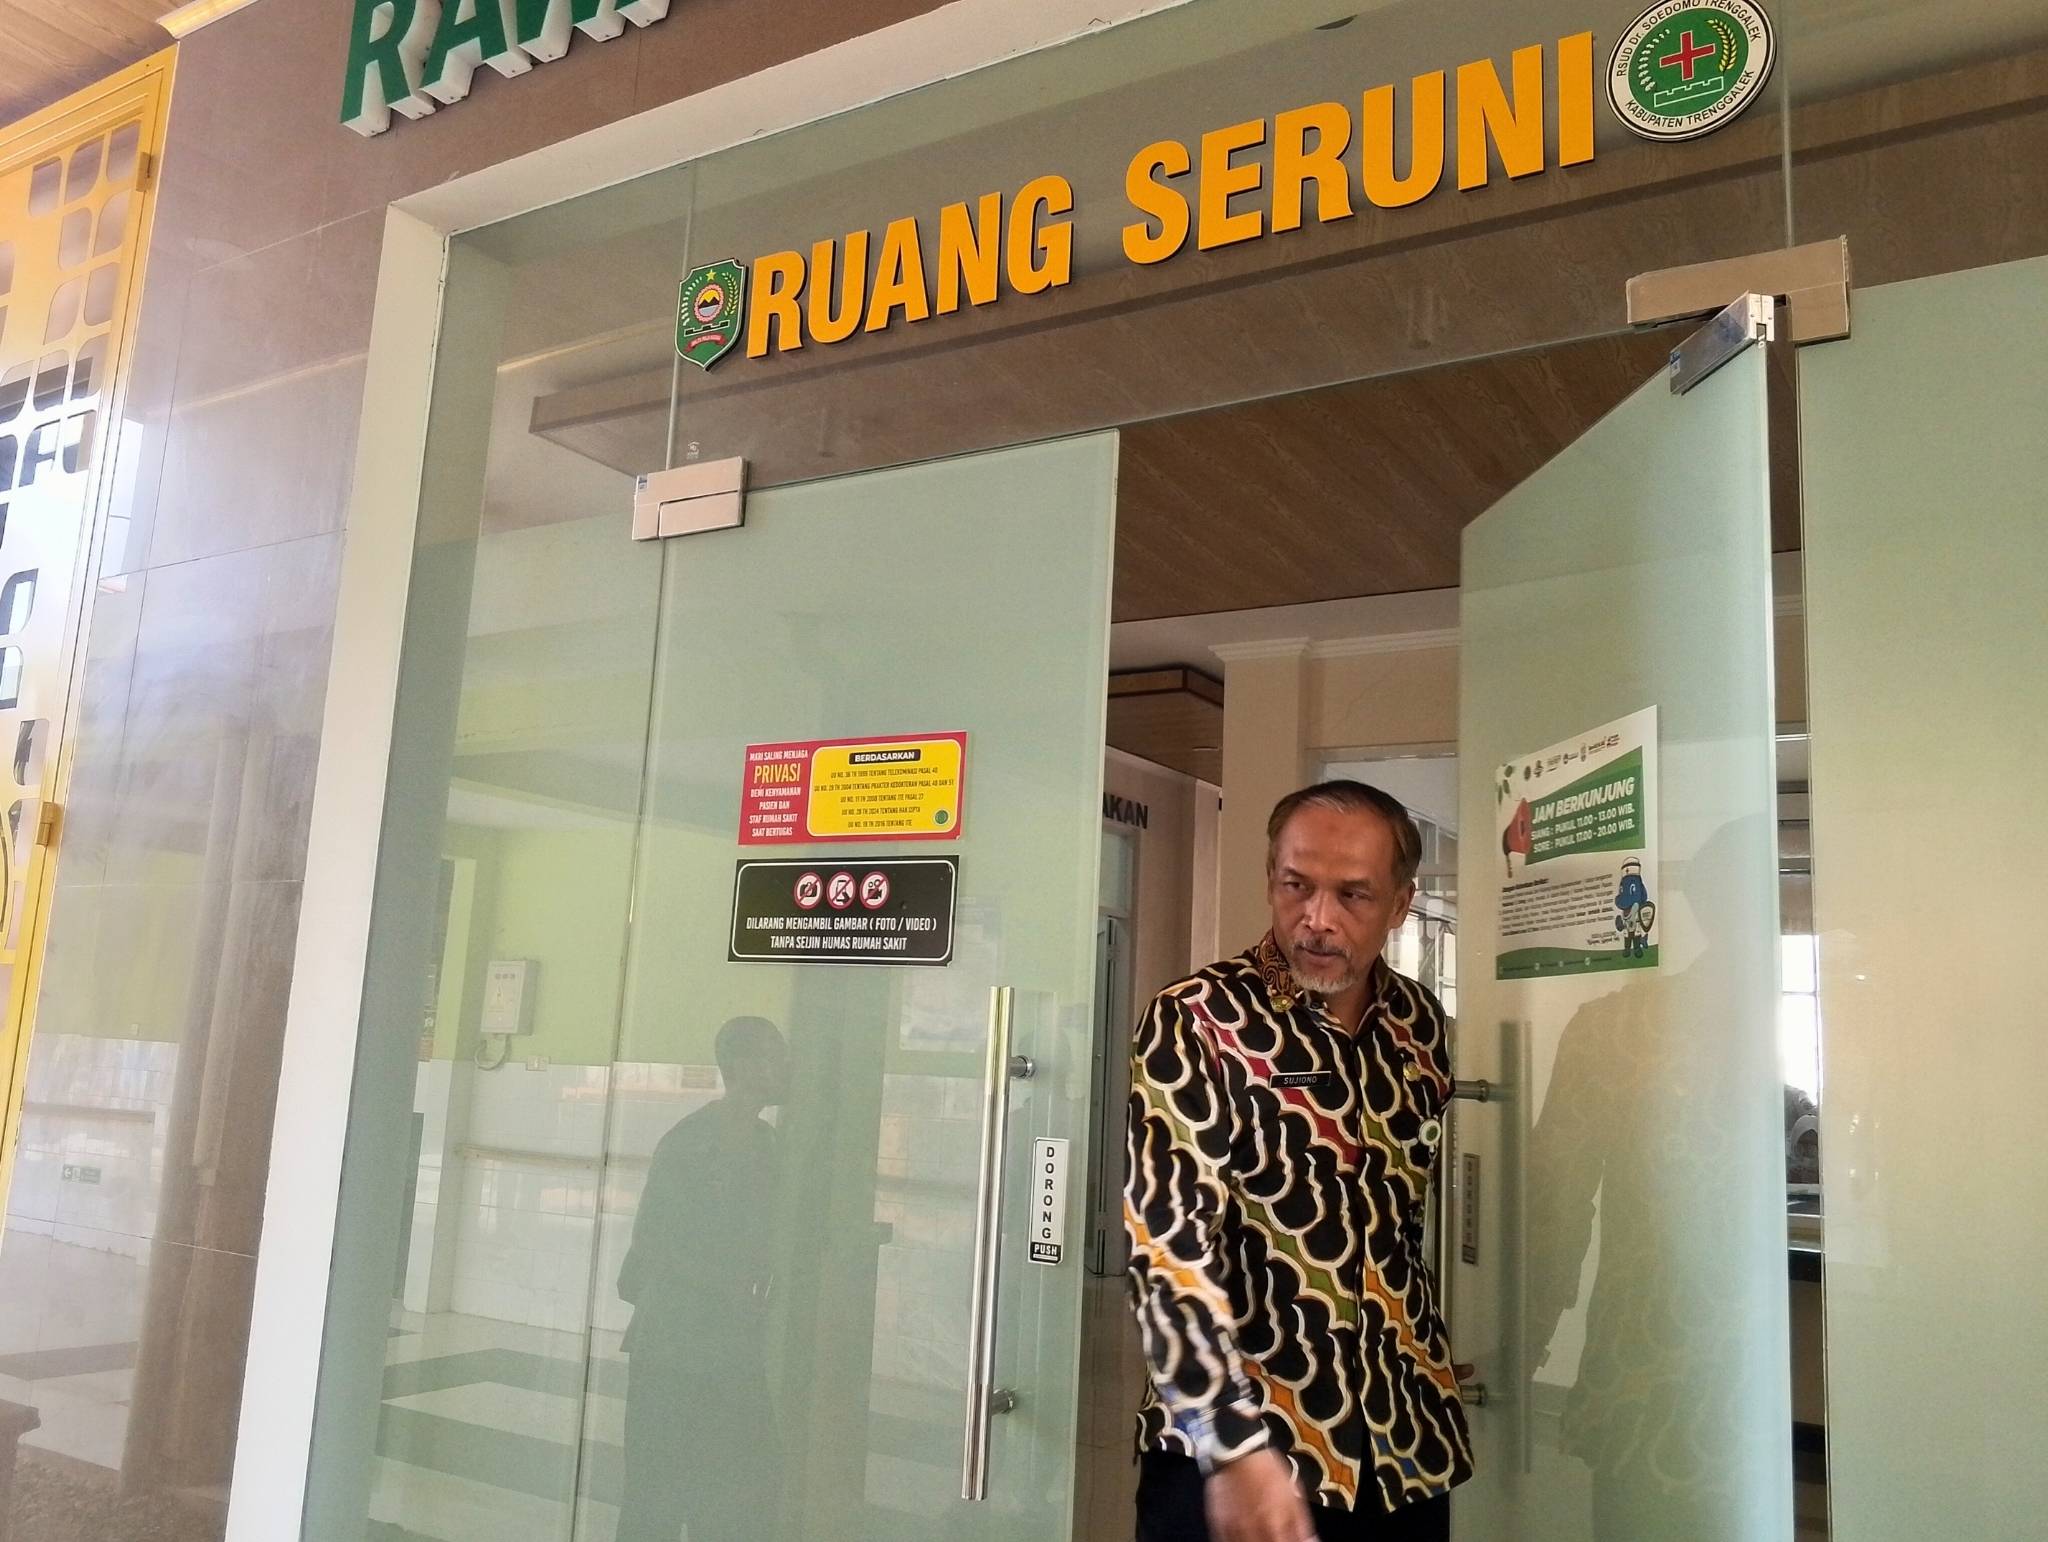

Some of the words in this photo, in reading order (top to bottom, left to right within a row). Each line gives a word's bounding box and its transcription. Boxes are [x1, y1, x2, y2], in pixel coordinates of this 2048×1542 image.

[1616, 49, 1632, 77] RSUD
[1630, 32, 1645, 46] Dr.
[1642, 0, 1700, 31] SOEDOMO
[1704, 0, 1762, 42] TRENGGALEK
[1625, 99, 1683, 128] KABUPATEN
[1686, 70, 1754, 126] TRENGGALEK
[746, 175, 1074, 359] RUANG
[1122, 31, 1594, 265] SERUNI
[764, 752, 783, 760] SALING
[783, 749, 808, 759] MENJAGA
[854, 751, 915, 763] BERDASARKAN
[753, 763, 801, 784] PRIVASI
[765, 787, 801, 797] KENYAMANAN
[852, 782, 870, 790] TENTANG
[759, 801, 778, 810] PASIEN
[778, 800, 790, 809] DAN
[1532, 802, 1556, 824] JAM
[1555, 776, 1635, 817] BERKUNJUNG
[749, 815, 762, 824] STAF
[762, 814, 782, 823] RUMAH
[782, 813, 798, 822] SAKIT
[1555, 819, 1576, 834] PUKUL
[1617, 802, 1635, 817] WIB.
[752, 828, 765, 837] SAAT
[765, 827, 793, 837] BERTUGAS
[1554, 834, 1575, 848] PUKUL
[1597, 822, 1617, 838] 20.00
[1617, 818, 1635, 832] WIB.
[746, 917, 784, 930] DILARANG
[786, 917, 832, 930] MENGAMBIL
[833, 917, 868, 930] GAMBAR
[875, 917, 897, 931] FOTO
[897, 917, 904, 931] /
[905, 917, 931, 931] VIDEO
[770, 935, 795, 949] TANPA
[795, 935, 821, 949] SEIJIN
[822, 936, 851, 950] HUMAS
[852, 936, 882, 950] RUMAH
[883, 937, 908, 950] SAKIT
[1283, 1076, 1317, 1085] SUJIONO
[1041, 1146, 1055, 1239] DORONG
[1034, 1243, 1058, 1256] PUSH
